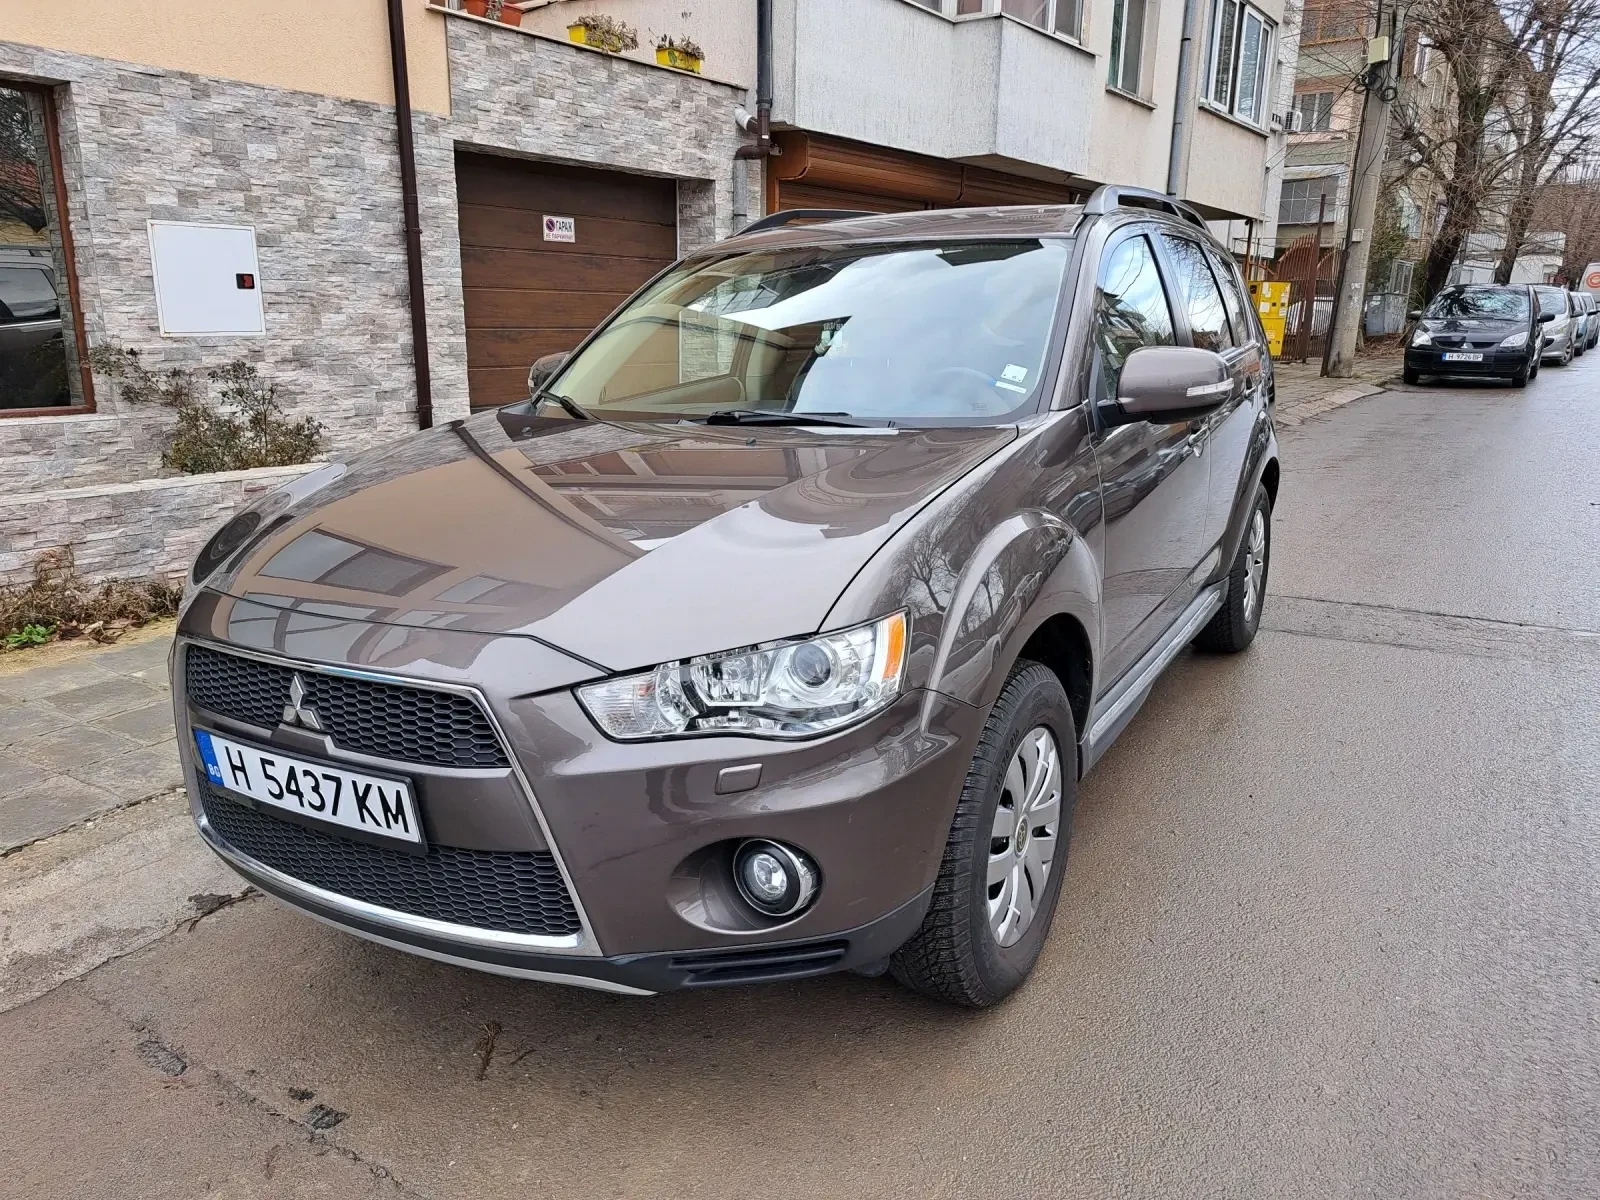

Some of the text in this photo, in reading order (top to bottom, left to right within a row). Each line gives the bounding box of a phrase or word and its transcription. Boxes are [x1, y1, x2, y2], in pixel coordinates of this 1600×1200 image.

[555, 220, 573, 232] ГАРАЖ
[208, 763, 221, 779] BG
[224, 745, 410, 834] H 5437 KM
